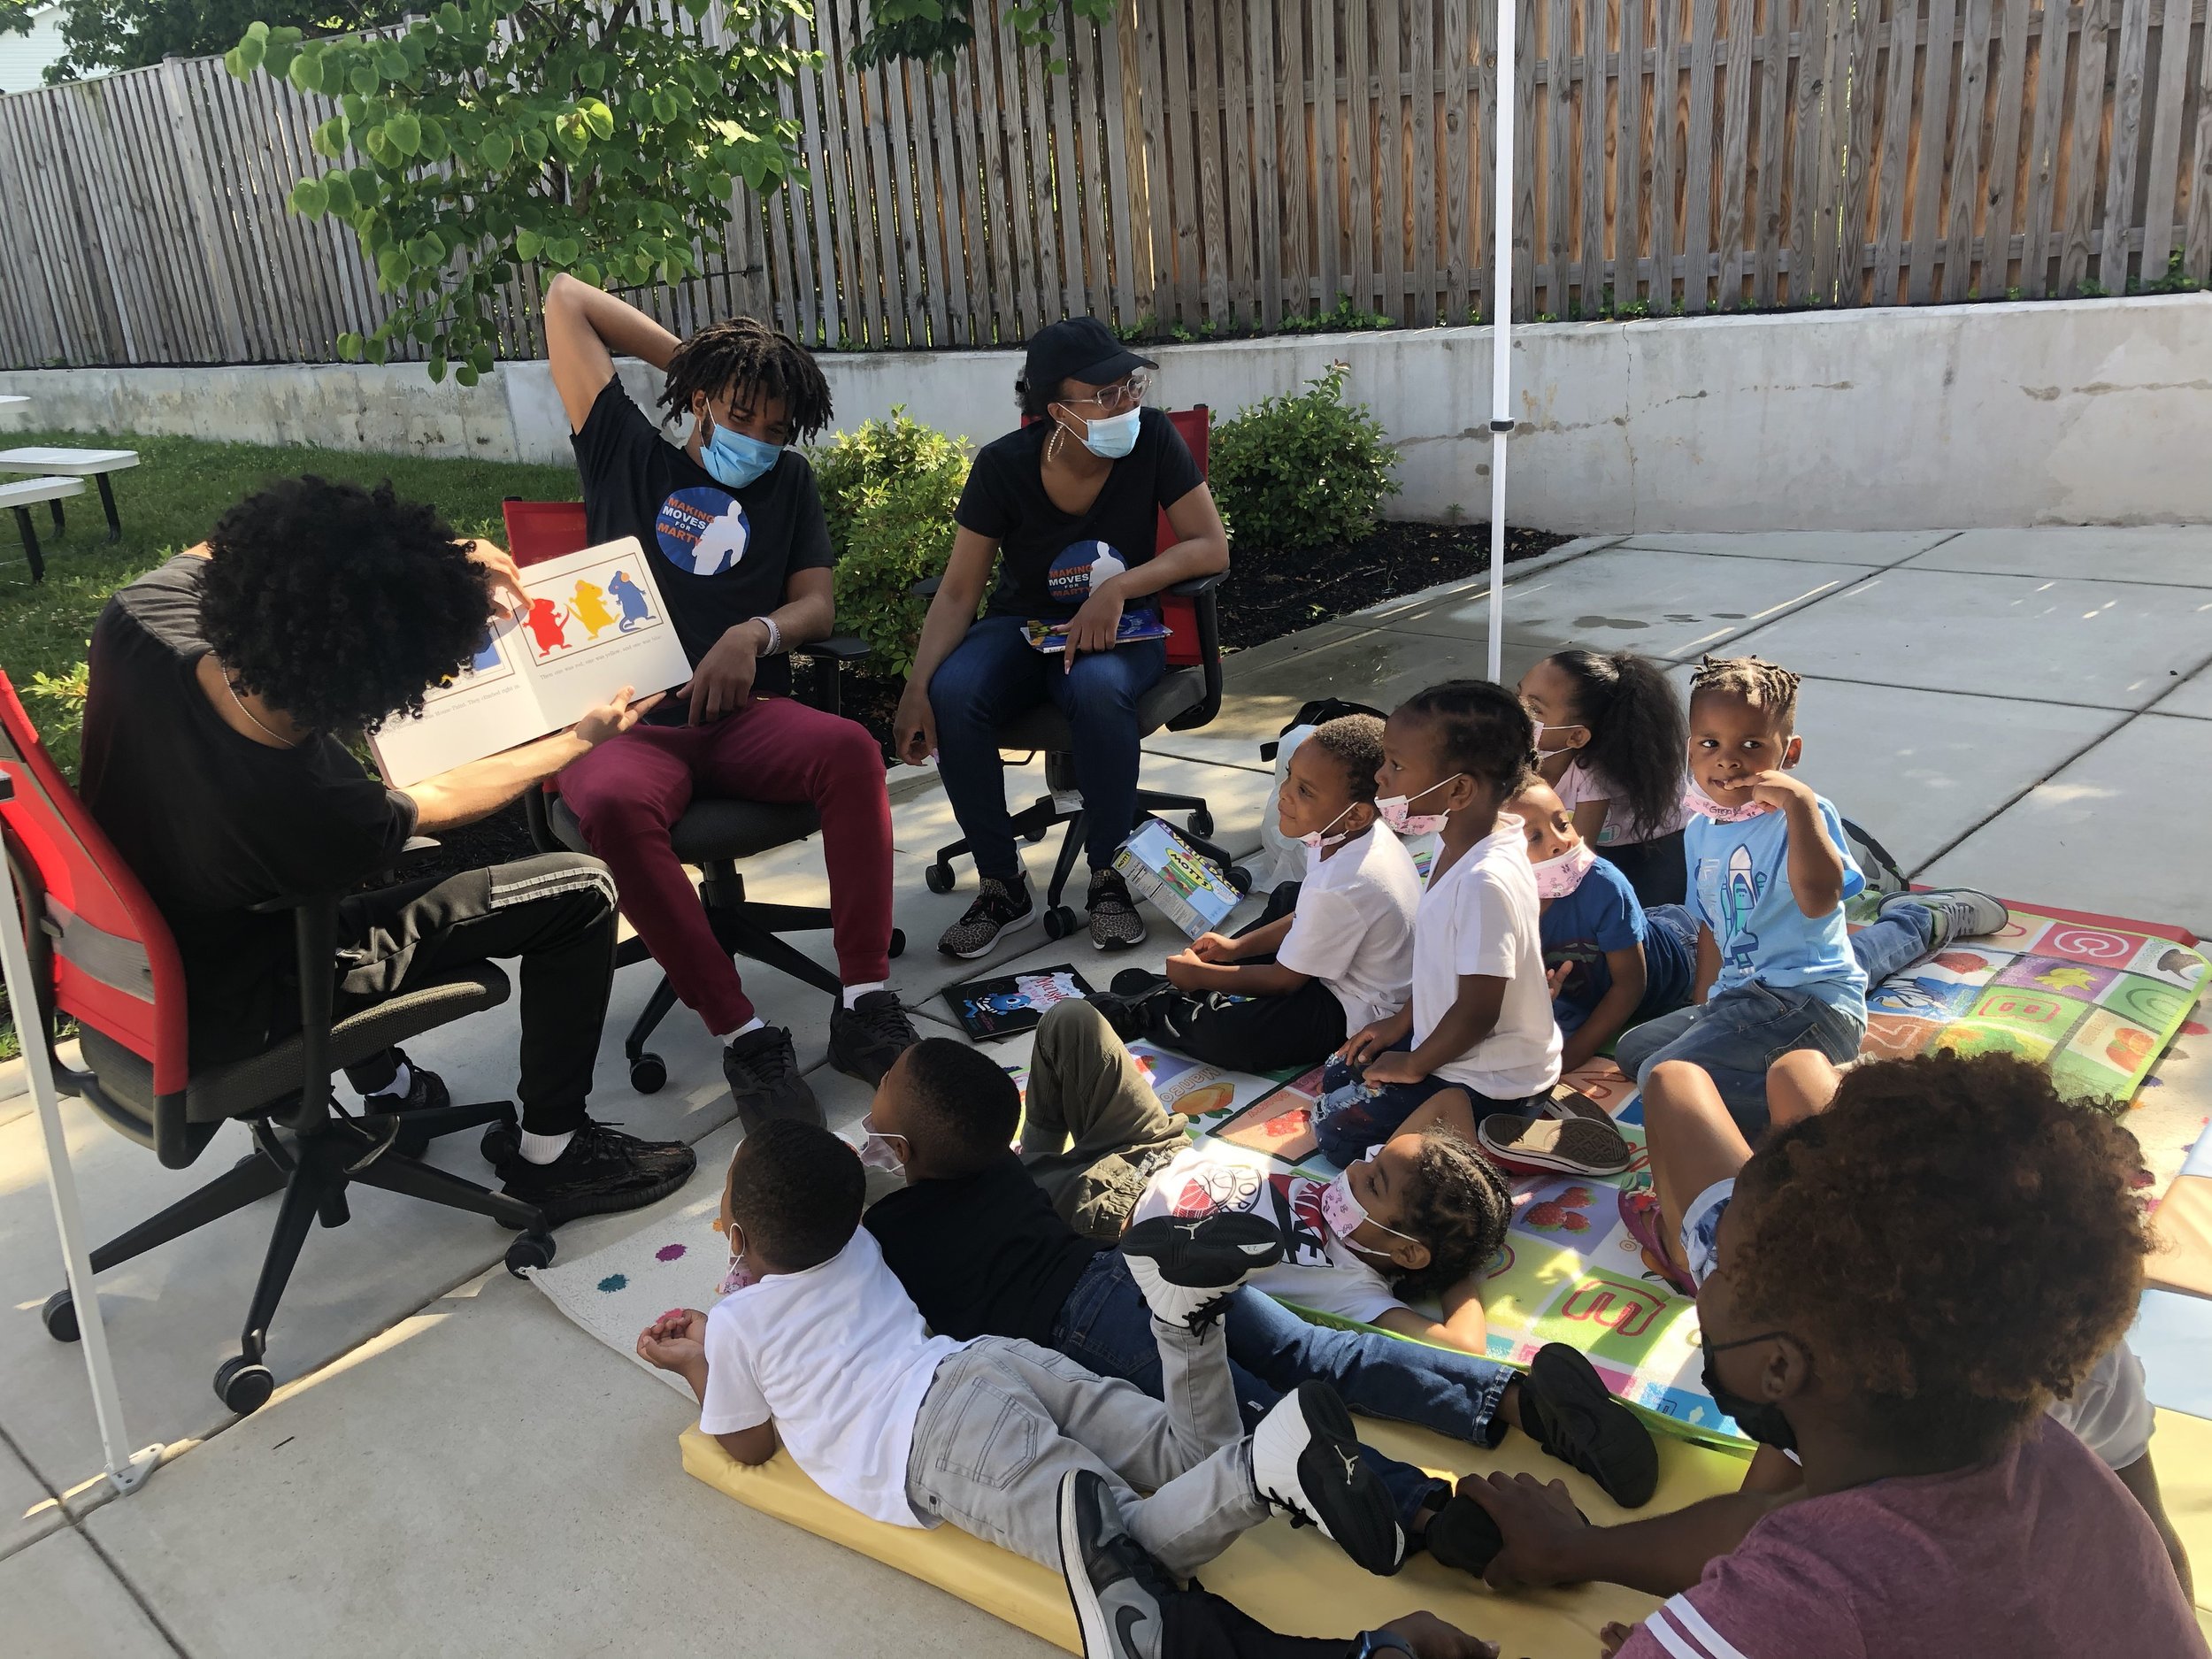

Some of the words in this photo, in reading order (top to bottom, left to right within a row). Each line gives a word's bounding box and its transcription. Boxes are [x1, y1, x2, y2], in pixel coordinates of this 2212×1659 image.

[662, 506, 707, 530] MOVES
[667, 497, 715, 524] MAKING
[657, 522, 703, 546] MARTY
[674, 521, 691, 531] FOR
[1048, 573, 1089, 587] MOVES
[1049, 564, 1094, 579] MAKING
[1050, 586, 1093, 597] MARTY
[1171, 853, 1208, 887] MOTTS
[1172, 832, 1208, 866] VALUE
[1208, 866, 1240, 898] PACK
[2054, 931, 2129, 957] C
[1035, 976, 1069, 1002] Monst
